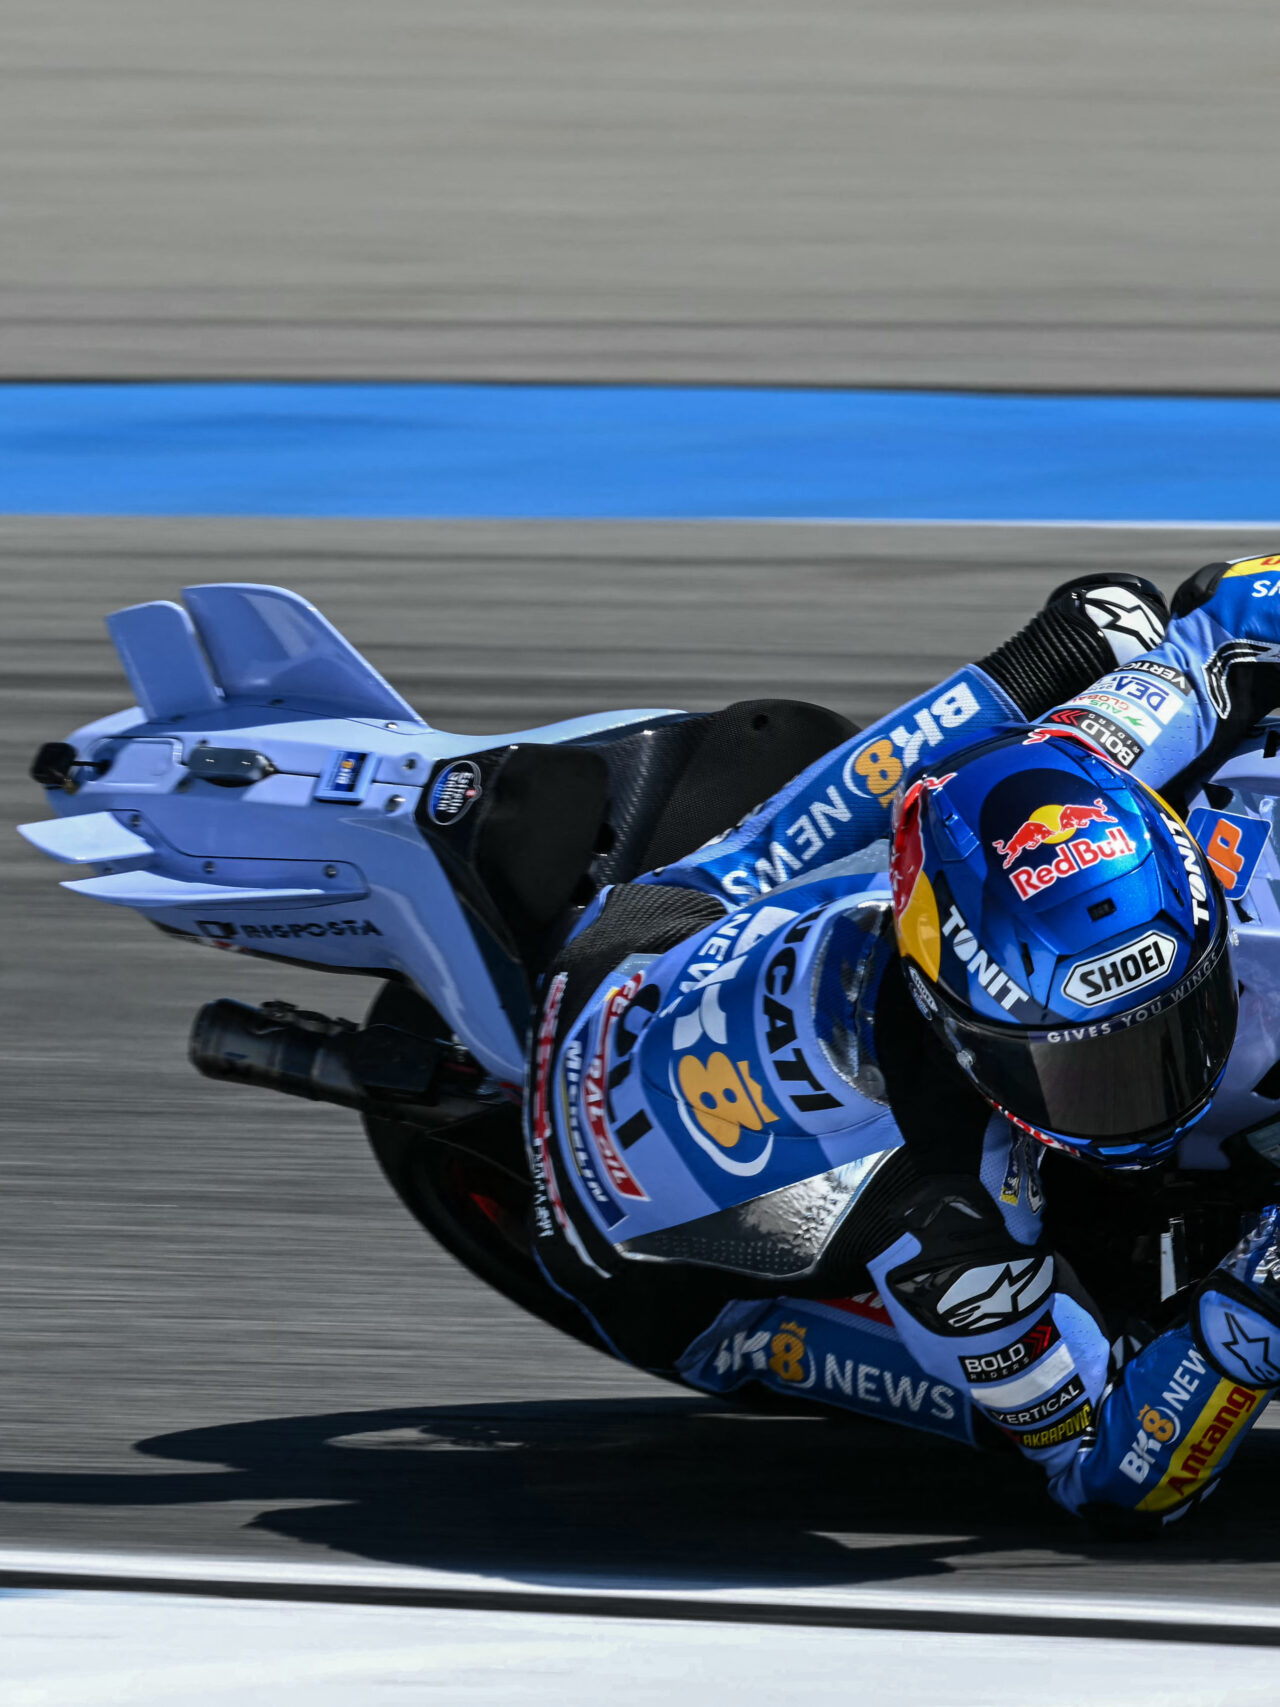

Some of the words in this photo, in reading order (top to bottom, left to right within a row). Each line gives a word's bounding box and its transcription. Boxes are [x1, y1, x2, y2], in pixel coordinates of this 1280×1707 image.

[1089, 699, 1123, 714] AUS
[1114, 661, 1186, 689] VERTIC
[855, 681, 982, 796] BK8
[1080, 719, 1136, 767] BOLD
[1088, 713, 1140, 754] RIDERS
[722, 785, 853, 903] NEWS
[1009, 844, 1079, 900] Red
[1068, 826, 1137, 869] Bull
[1160, 812, 1210, 926] TONIT
[941, 904, 1031, 1012] TONIT
[1079, 940, 1166, 999] SHOEI
[1047, 1022, 1112, 1044] GIVES
[1121, 1001, 1163, 1027] YOU
[1170, 951, 1218, 1001] WINGS
[585, 978, 638, 1122] FERAL
[823, 1352, 957, 1420] NEWS
[964, 1343, 1026, 1373] BOLD
[970, 1357, 1030, 1380] RIDERS
[991, 1383, 1080, 1424] VERTICAL
[1119, 1406, 1177, 1485] BK8
[1161, 1347, 1207, 1412] NEW
[1166, 1385, 1258, 1497] Antang
